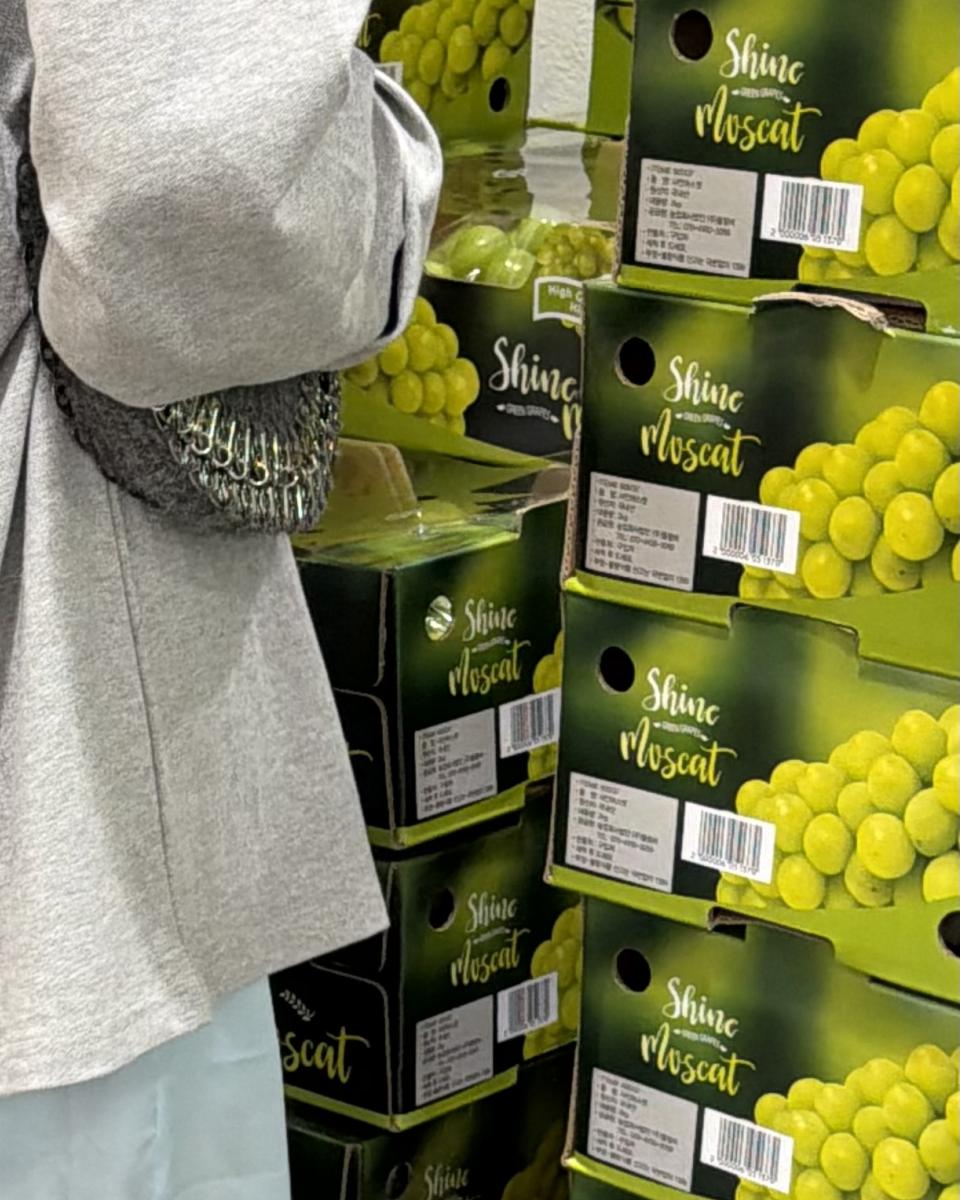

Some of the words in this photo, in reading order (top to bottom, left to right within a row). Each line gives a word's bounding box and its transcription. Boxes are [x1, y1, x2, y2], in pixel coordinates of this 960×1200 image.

[719, 28, 804, 85] Shine
[695, 84, 822, 153] Moscat
[488, 336, 577, 402] Shine
[663, 355, 744, 413] Shine
[641, 408, 761, 477] Moscat
[462, 598, 516, 642] Shine
[448, 640, 531, 697] Moscat
[641, 666, 720, 727] Shine
[620, 718, 738, 787] Moscat
[468, 892, 517, 933] Shine
[451, 930, 530, 988] Moscat
[661, 976, 739, 1039] Shine
[280, 1026, 371, 1084] scat
[641, 1024, 755, 1096] Moscat
